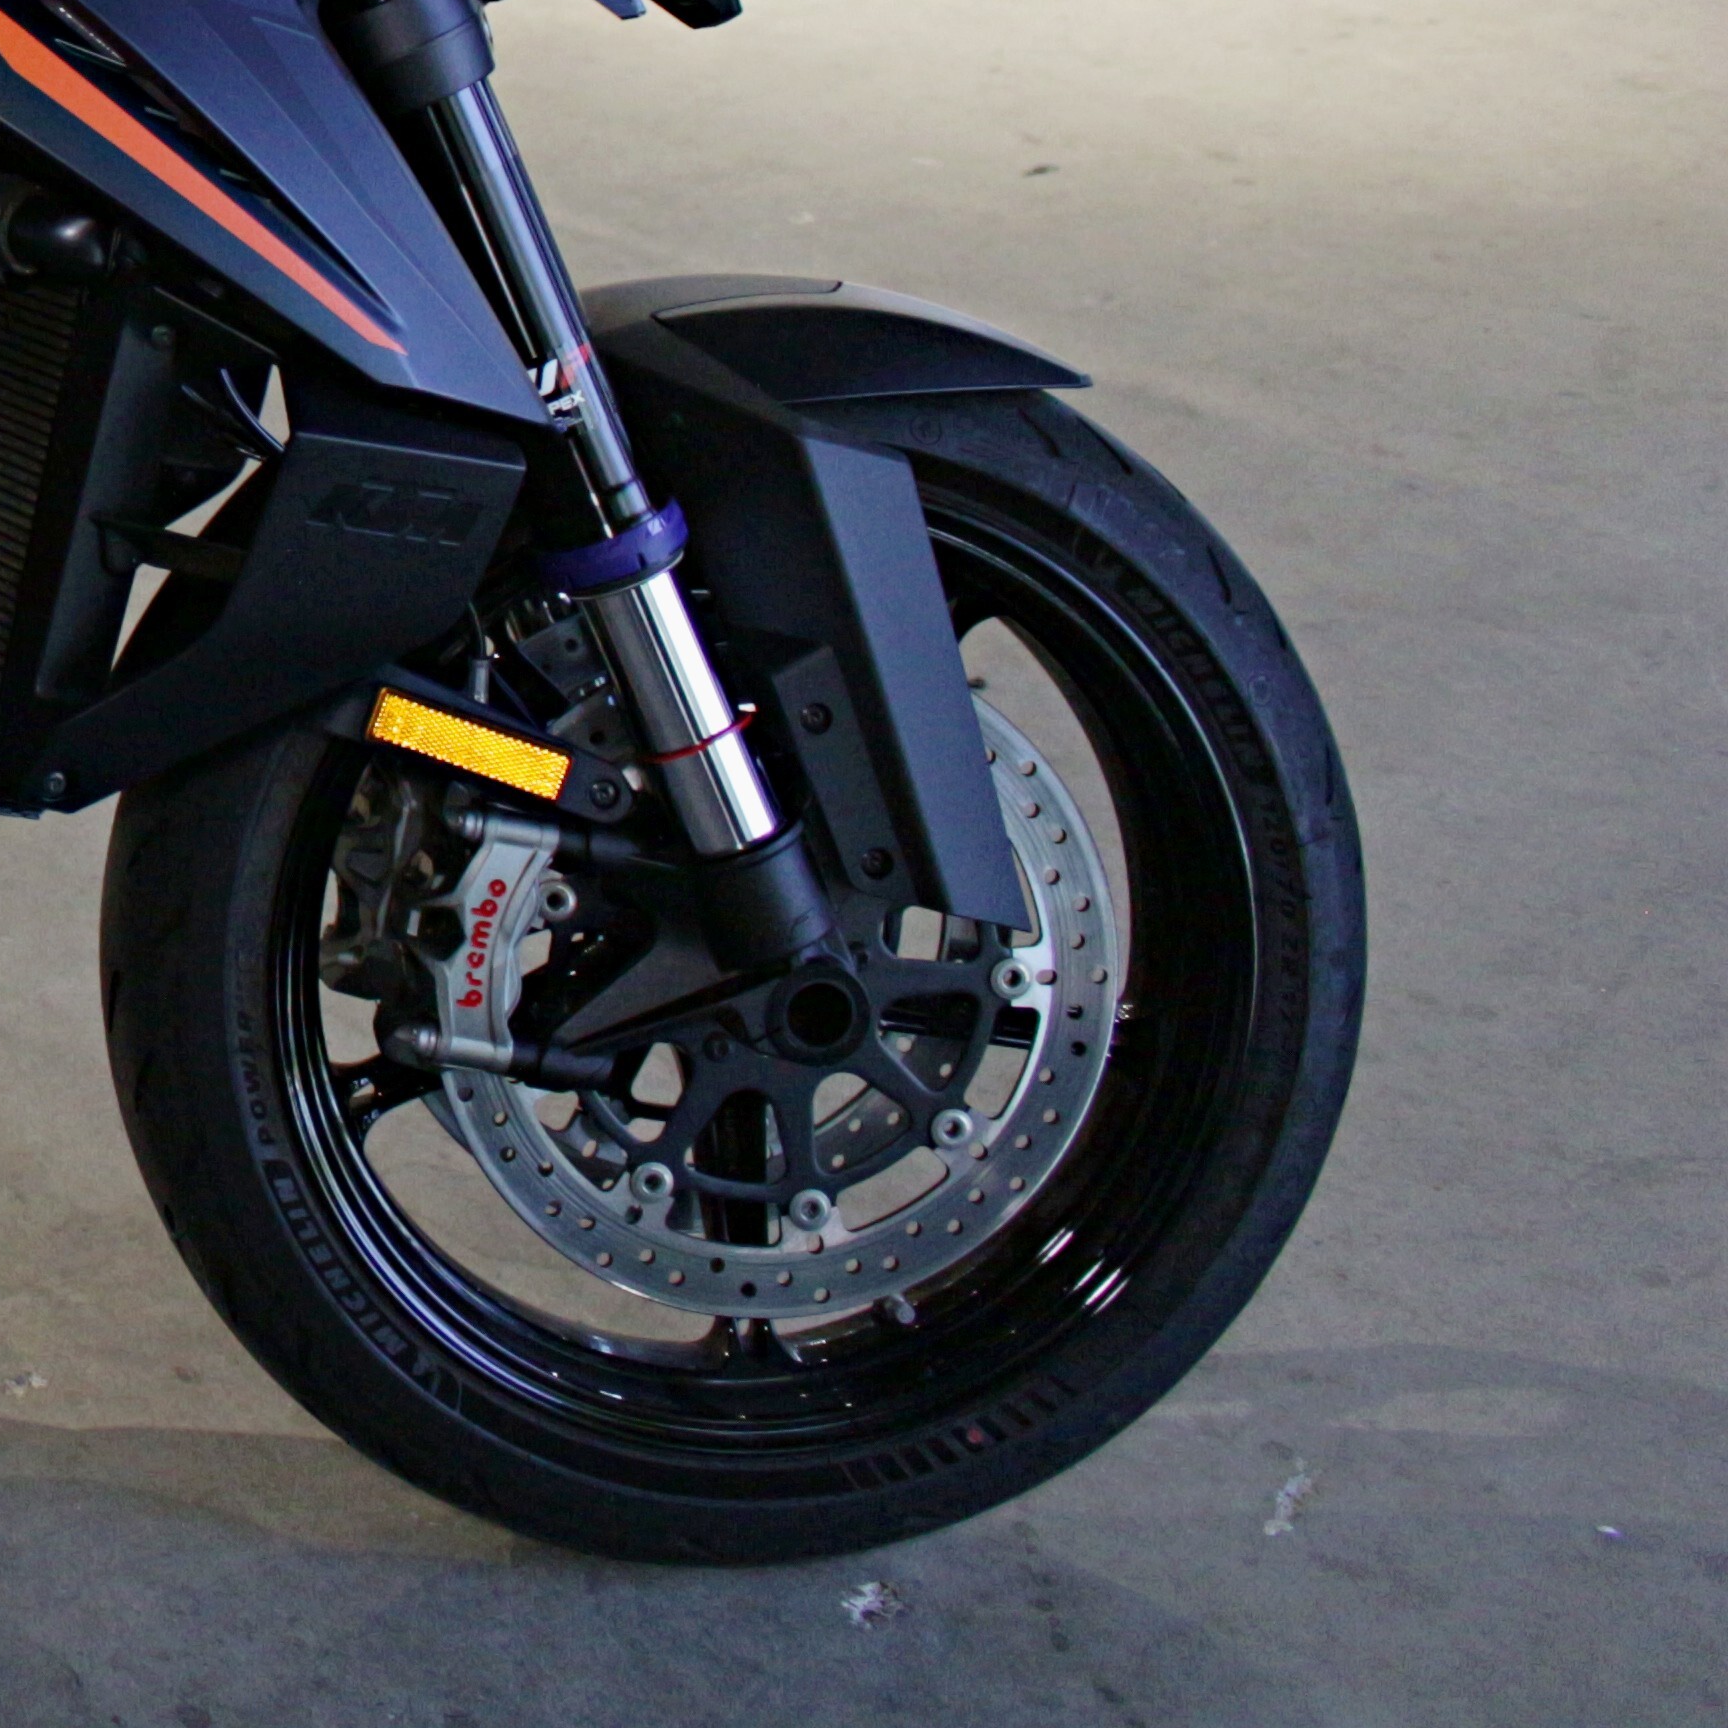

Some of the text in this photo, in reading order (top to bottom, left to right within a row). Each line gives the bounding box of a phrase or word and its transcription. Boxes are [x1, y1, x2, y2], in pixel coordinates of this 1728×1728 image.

[546, 389, 586, 416] PEX
[455, 878, 507, 1008] brembo
[271, 1169, 409, 1357] MICHELIN
